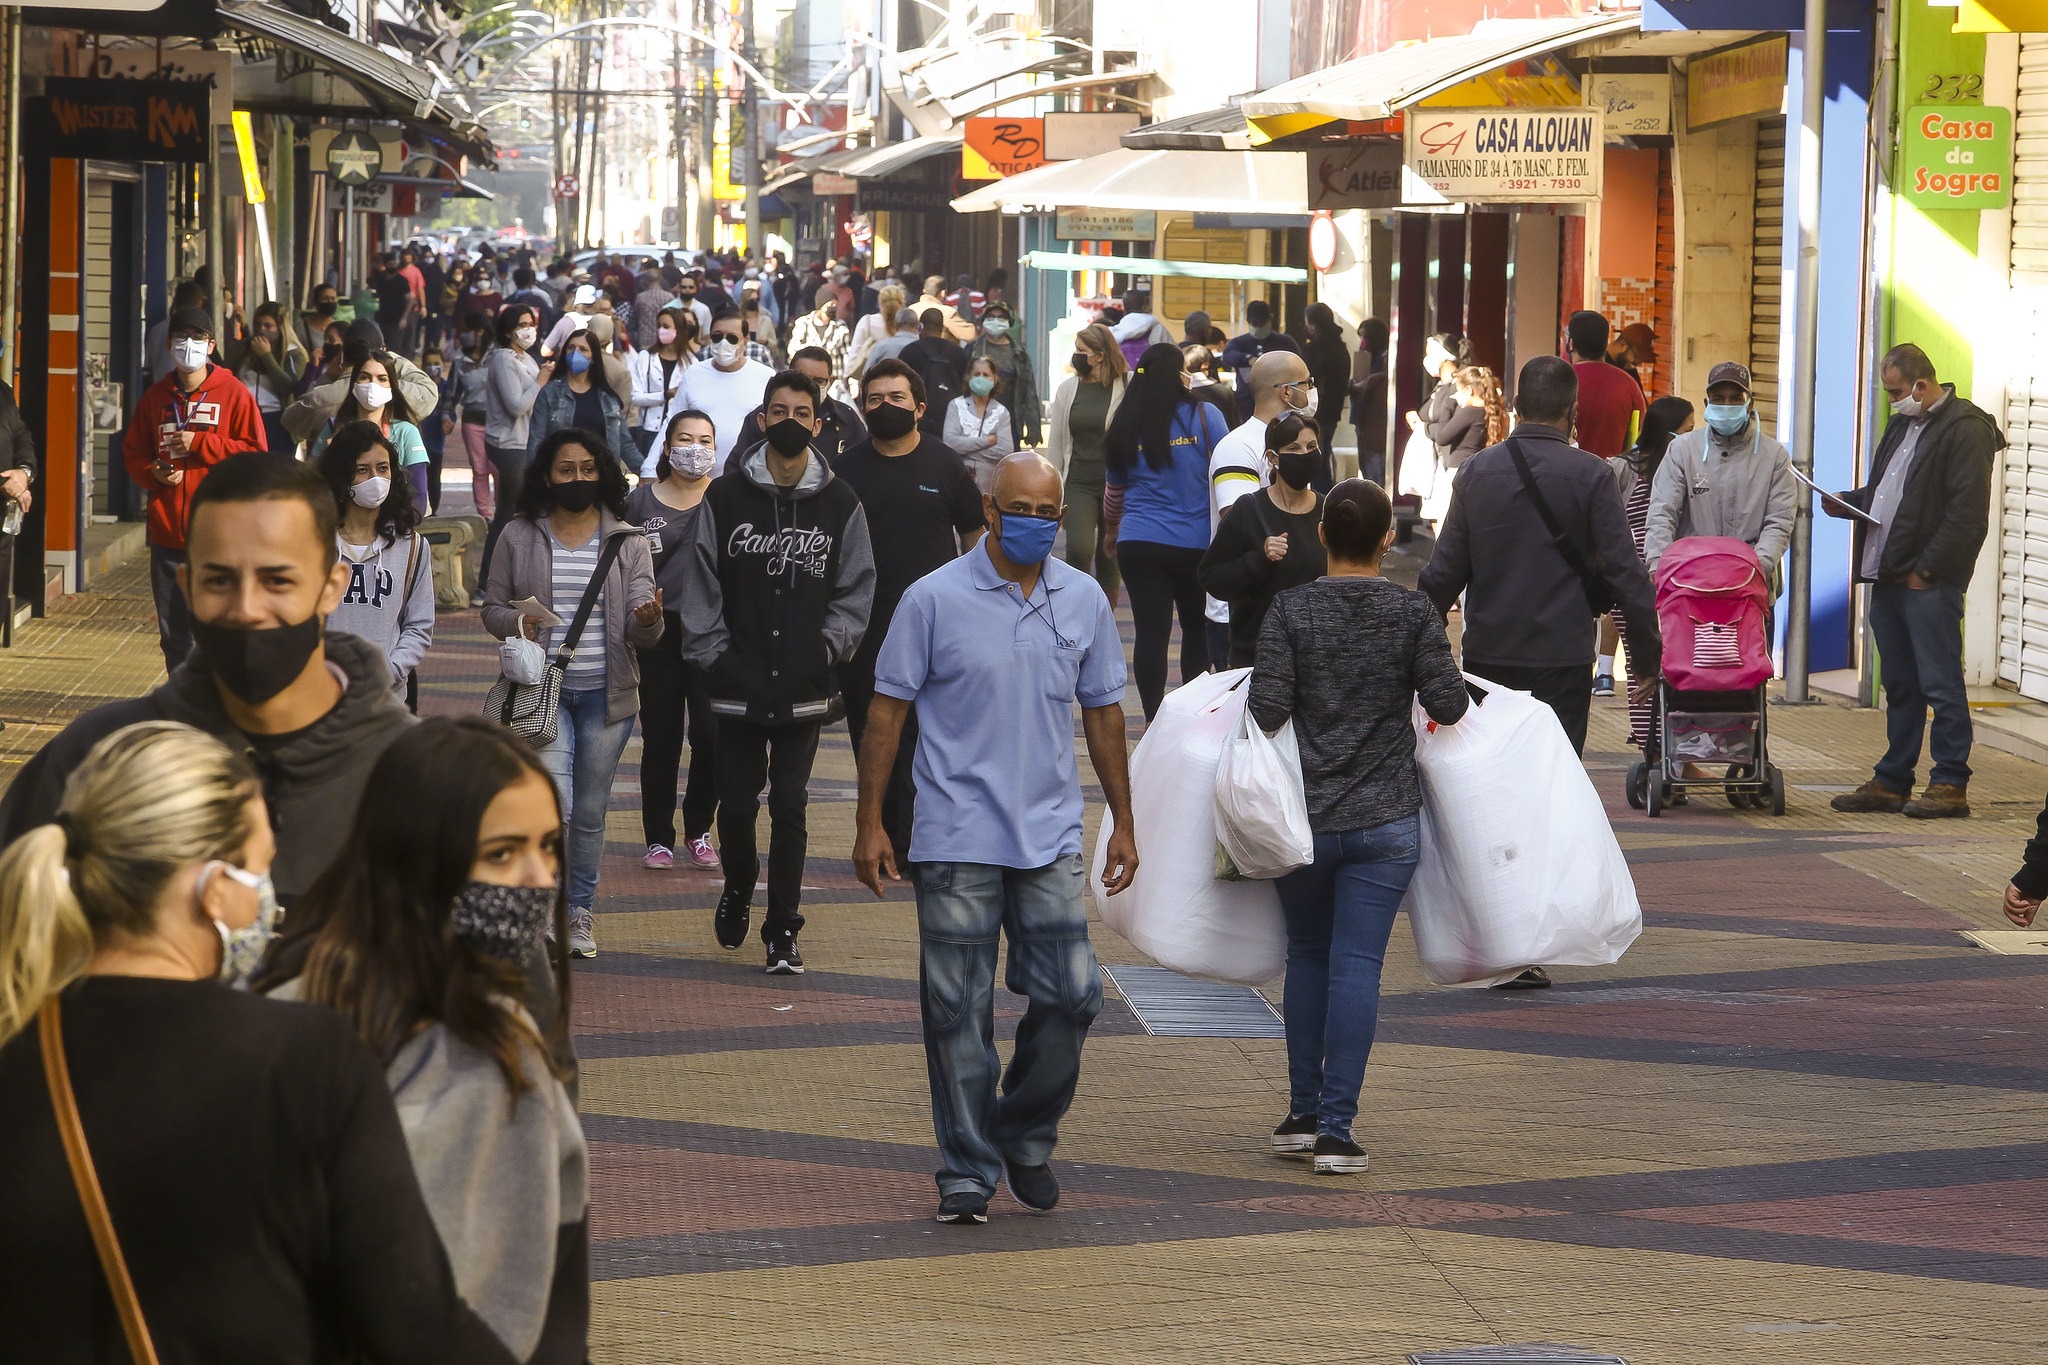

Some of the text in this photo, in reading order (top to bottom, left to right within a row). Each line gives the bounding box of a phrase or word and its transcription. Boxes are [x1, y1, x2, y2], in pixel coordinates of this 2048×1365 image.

[1920, 74, 1983, 99] 232
[51, 96, 138, 136] MISTER
[1921, 113, 1994, 140] Casa
[992, 124, 1040, 158] RD
[1475, 117, 1592, 154] CASA ALOUAN
[1418, 154, 1589, 178] TAMANHOS DE 34 À 76 MASC. E FEM.
[1945, 146, 1974, 164] da
[1509, 180, 1537, 190] 3921
[1551, 179, 1581, 189] 7930
[1914, 166, 2000, 197] Sogra
[728, 523, 833, 575] Gangster
[342, 563, 394, 610] AP
